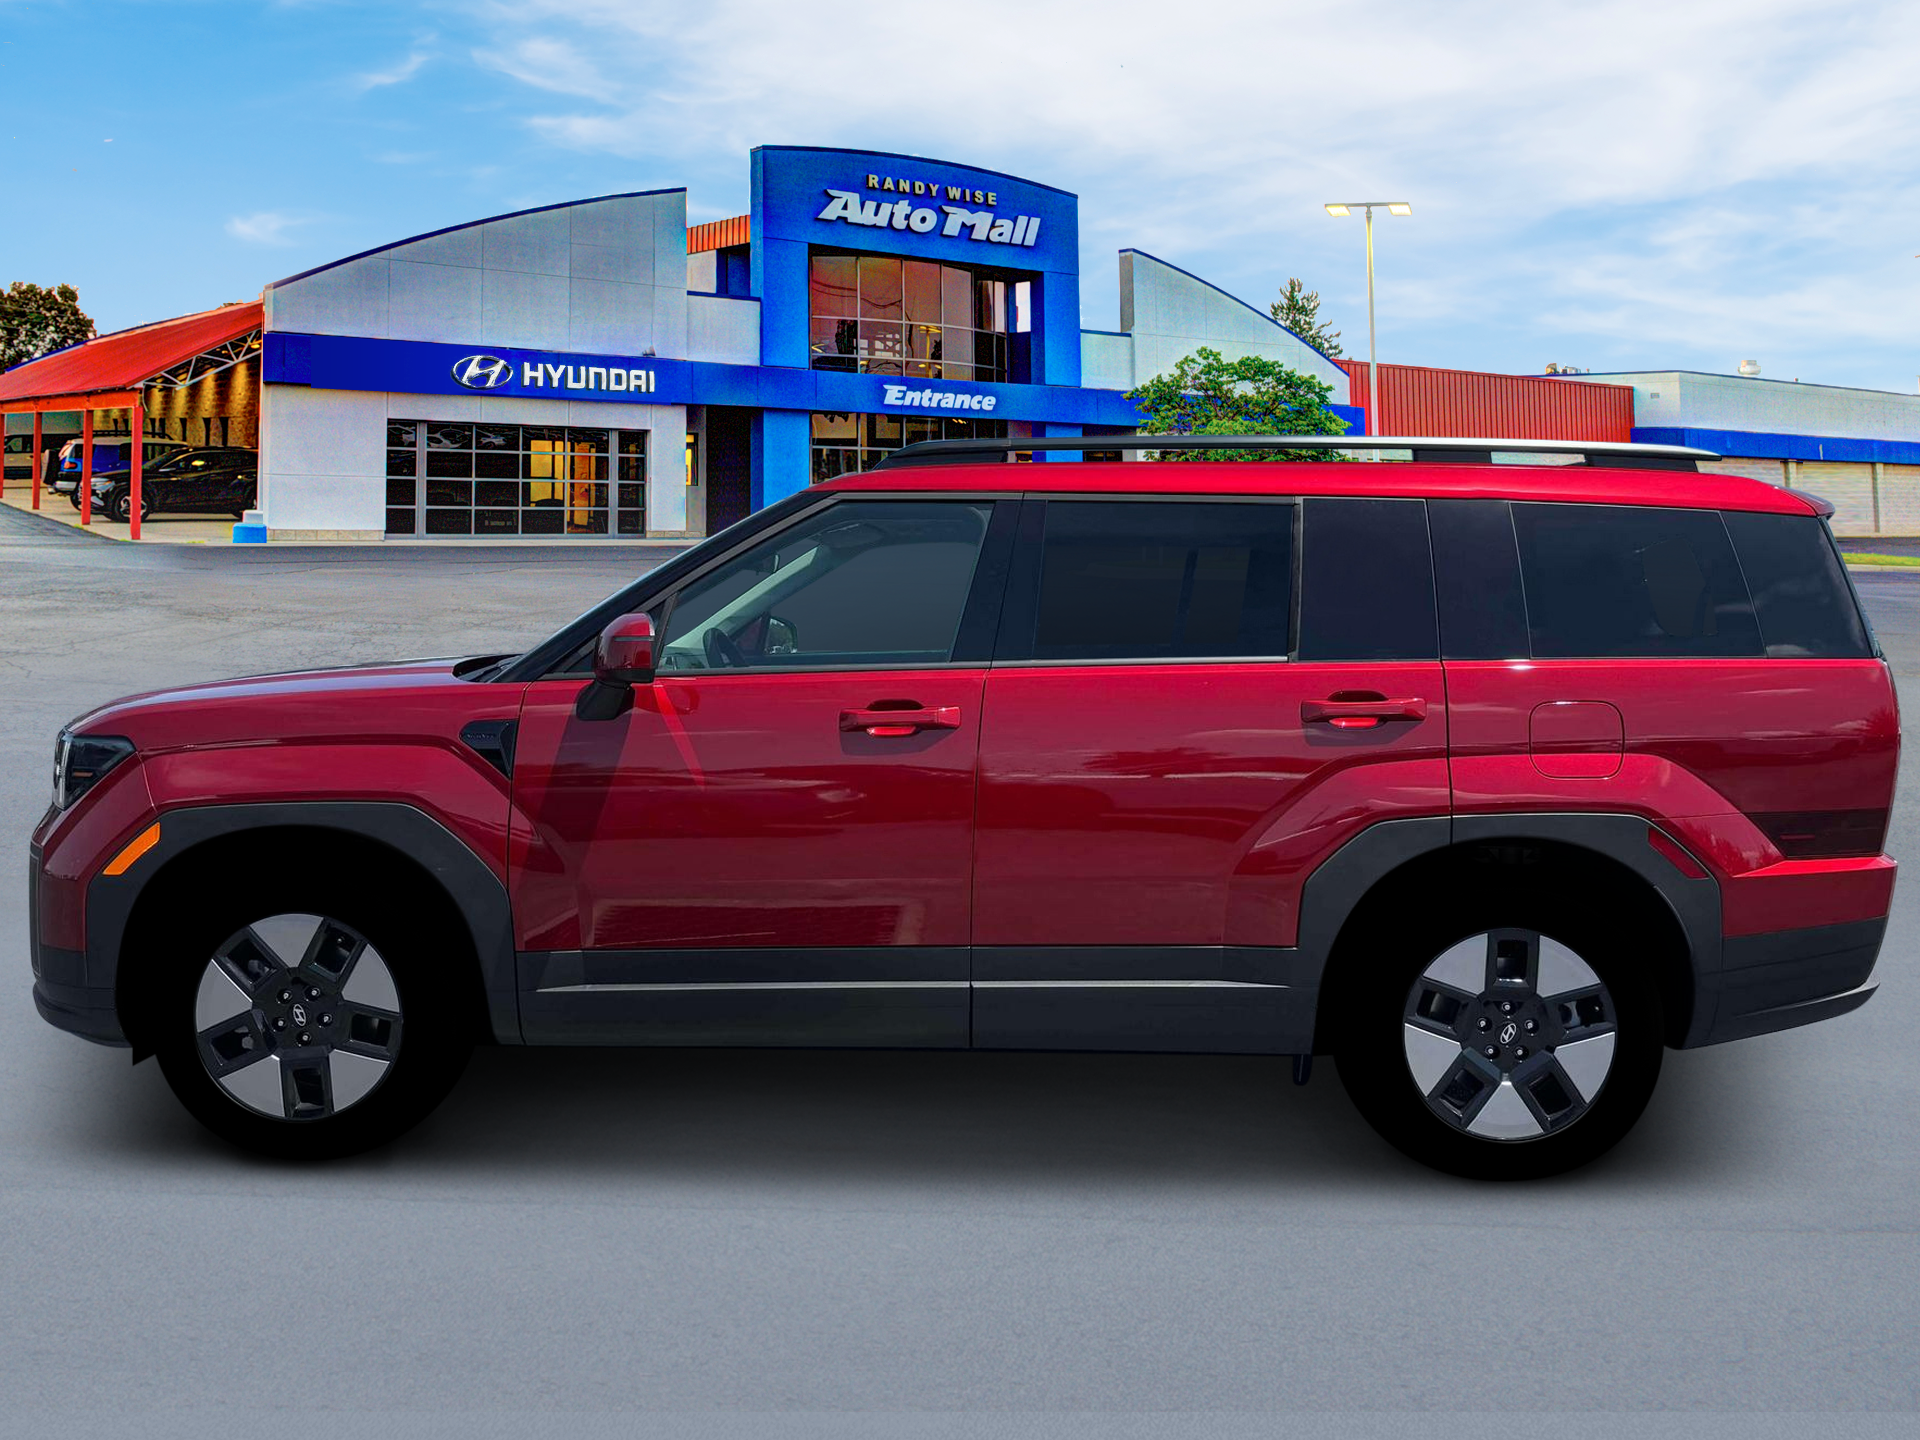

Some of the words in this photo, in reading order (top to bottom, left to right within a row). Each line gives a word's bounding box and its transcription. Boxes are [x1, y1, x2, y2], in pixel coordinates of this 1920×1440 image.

[867, 174, 939, 197] RANDY
[946, 186, 997, 206] WISE
[817, 188, 938, 233] Auto
[941, 205, 1041, 247] Mall
[522, 361, 656, 393] HYUNDAI
[882, 384, 997, 411] Entrance
